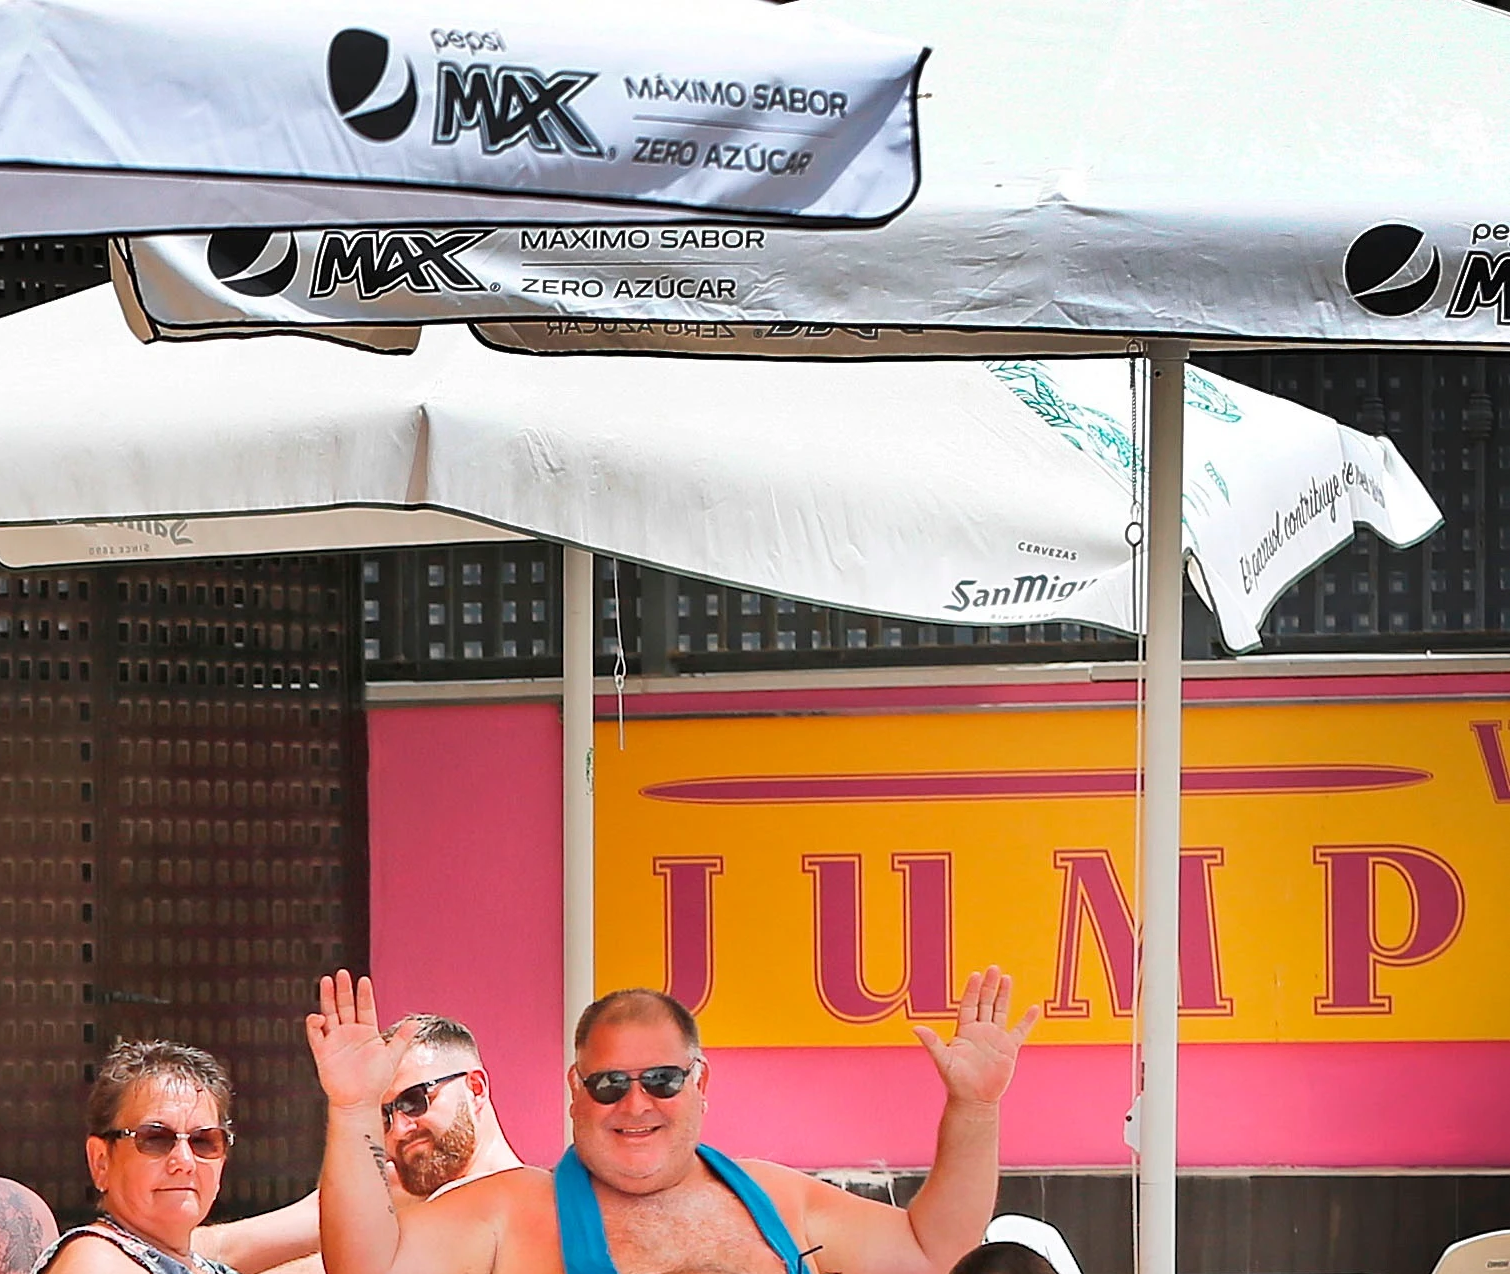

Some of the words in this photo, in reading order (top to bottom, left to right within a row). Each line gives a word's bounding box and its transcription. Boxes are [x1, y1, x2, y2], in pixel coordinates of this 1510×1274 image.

[430, 27, 507, 56] pepsi
[432, 62, 605, 159] MAX
[625, 74, 745, 110] MÁXIMO
[752, 83, 848, 119] SABOR
[631, 137, 700, 168] ZERO
[705, 140, 815, 177] AZÚCAR
[519, 226, 650, 251] MÁXIMO
[659, 229, 766, 251] SABOR
[309, 229, 497, 300] MAX
[521, 277, 603, 299] ZERO
[613, 272, 737, 301] AZÚCAR
[1017, 542, 1078, 561] CERVEZAS
